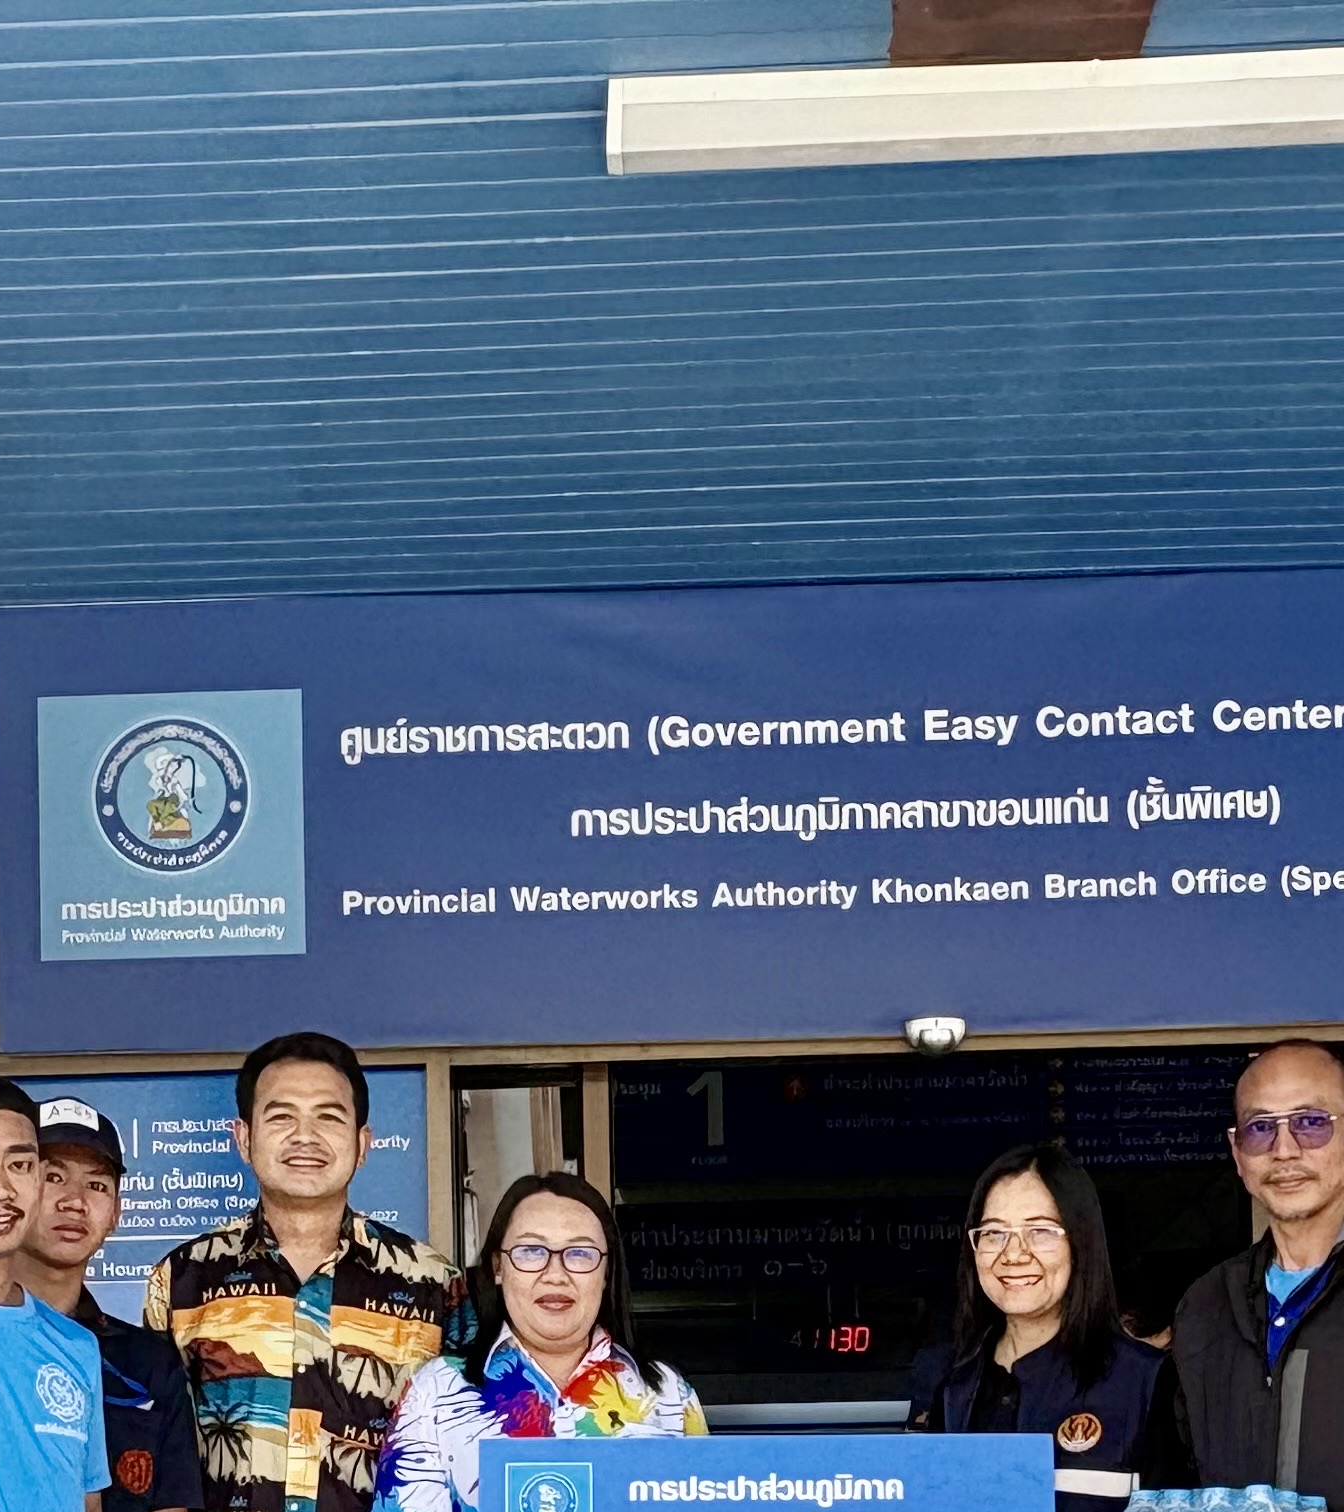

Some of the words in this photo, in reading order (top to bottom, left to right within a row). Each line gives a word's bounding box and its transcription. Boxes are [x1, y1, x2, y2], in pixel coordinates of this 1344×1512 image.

[340, 717, 630, 765] ศูนย์ราชการสะดวก
[647, 711, 907, 756] (Government
[924, 708, 1018, 746] Easy
[1035, 702, 1195, 738] Contact
[570, 787, 1109, 841] การประปาส่วนภูมิภาคสาขาขอนแก่น
[1126, 776, 1281, 829] (ชั้นพิเศษ)
[342, 887, 496, 916] Provincial
[509, 883, 698, 912] Waterworks
[711, 879, 858, 910] Authority
[871, 876, 1030, 904] Khonkaen
[1044, 870, 1157, 899] Branch
[1173, 867, 1267, 895] Office
[61, 893, 286, 922] การประปาส่วนภูมิภาค
[218, 922, 286, 942] Authority
[686, 1071, 725, 1147] 1
[151, 1117, 236, 1134] การประปาส่ว
[152, 1138, 232, 1155] Provincial
[370, 1134, 411, 1151] ority
[161, 1167, 244, 1194] (ชั้นพิเศษ)
[202, 1282, 277, 1303] HAWAII
[364, 1298, 435, 1323] HAWAII
[629, 1472, 904, 1508] การประปาส่วนภูมิภาค
